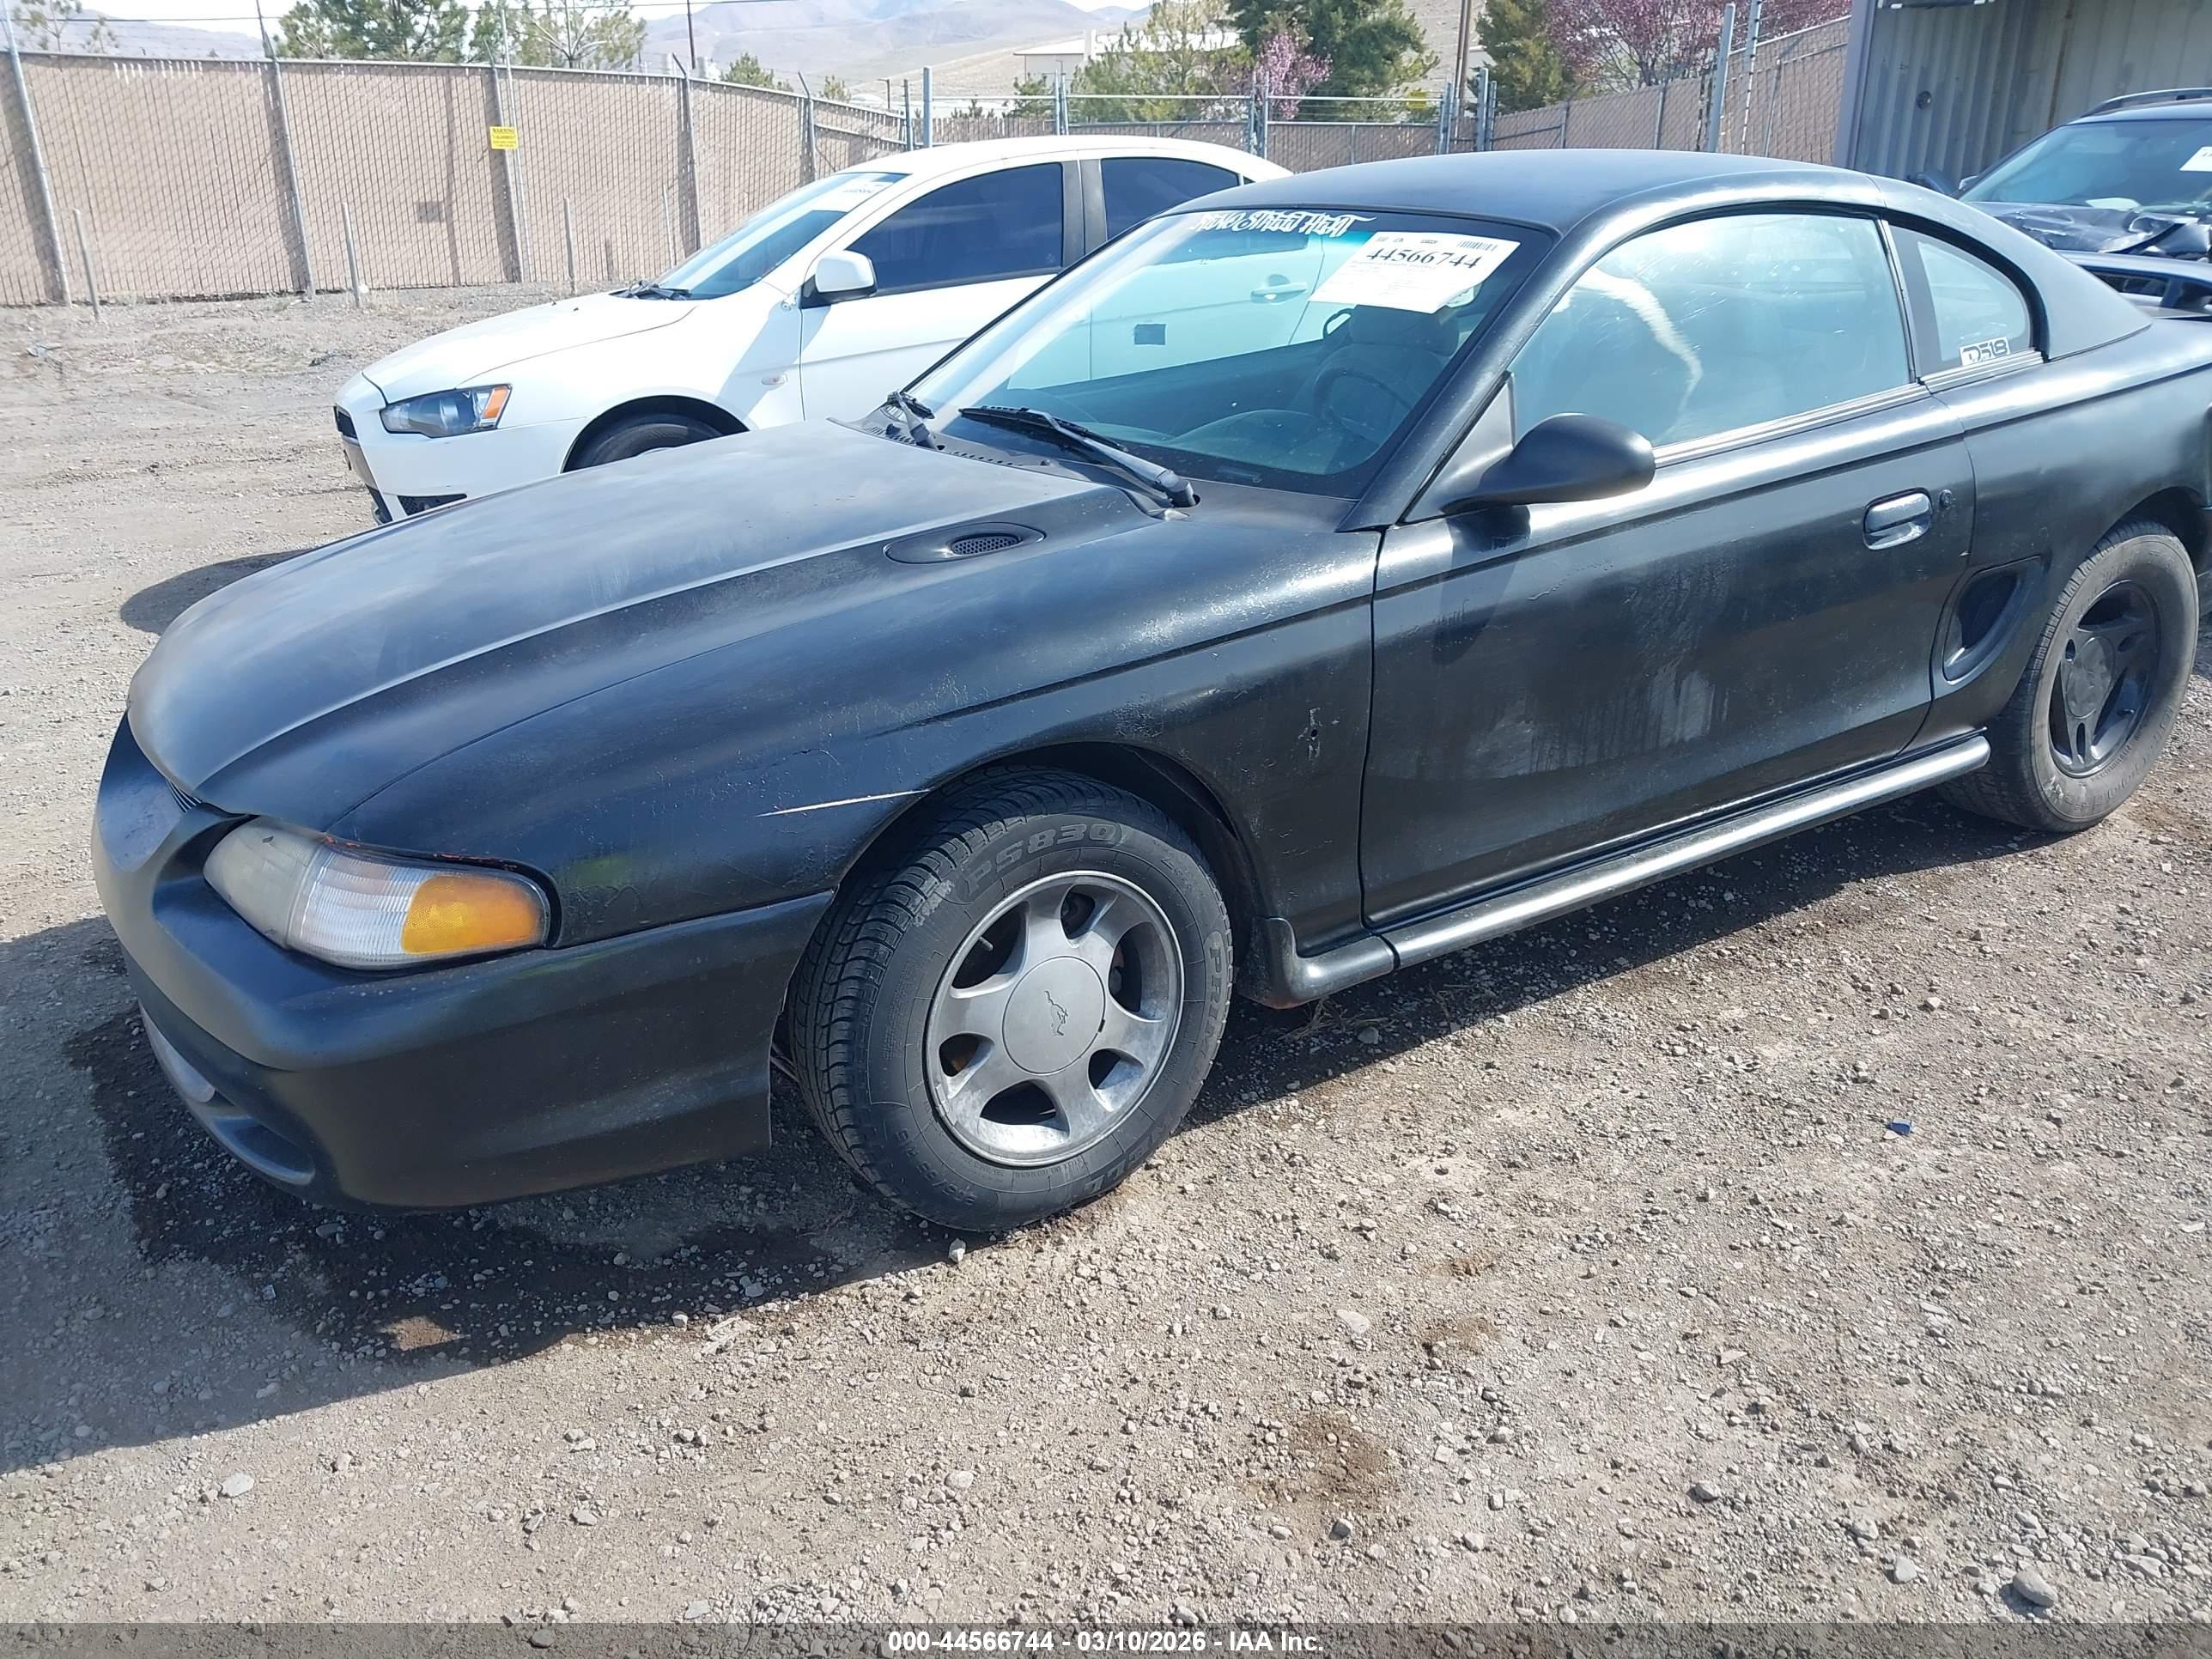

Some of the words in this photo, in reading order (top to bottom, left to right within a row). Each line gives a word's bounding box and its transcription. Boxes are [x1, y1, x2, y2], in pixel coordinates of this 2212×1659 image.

[1249, 210, 1306, 233] STREET
[1298, 212, 1376, 238] HEAT
[1367, 247, 1483, 269] 44566744
[965, 823, 1115, 898] PS830
